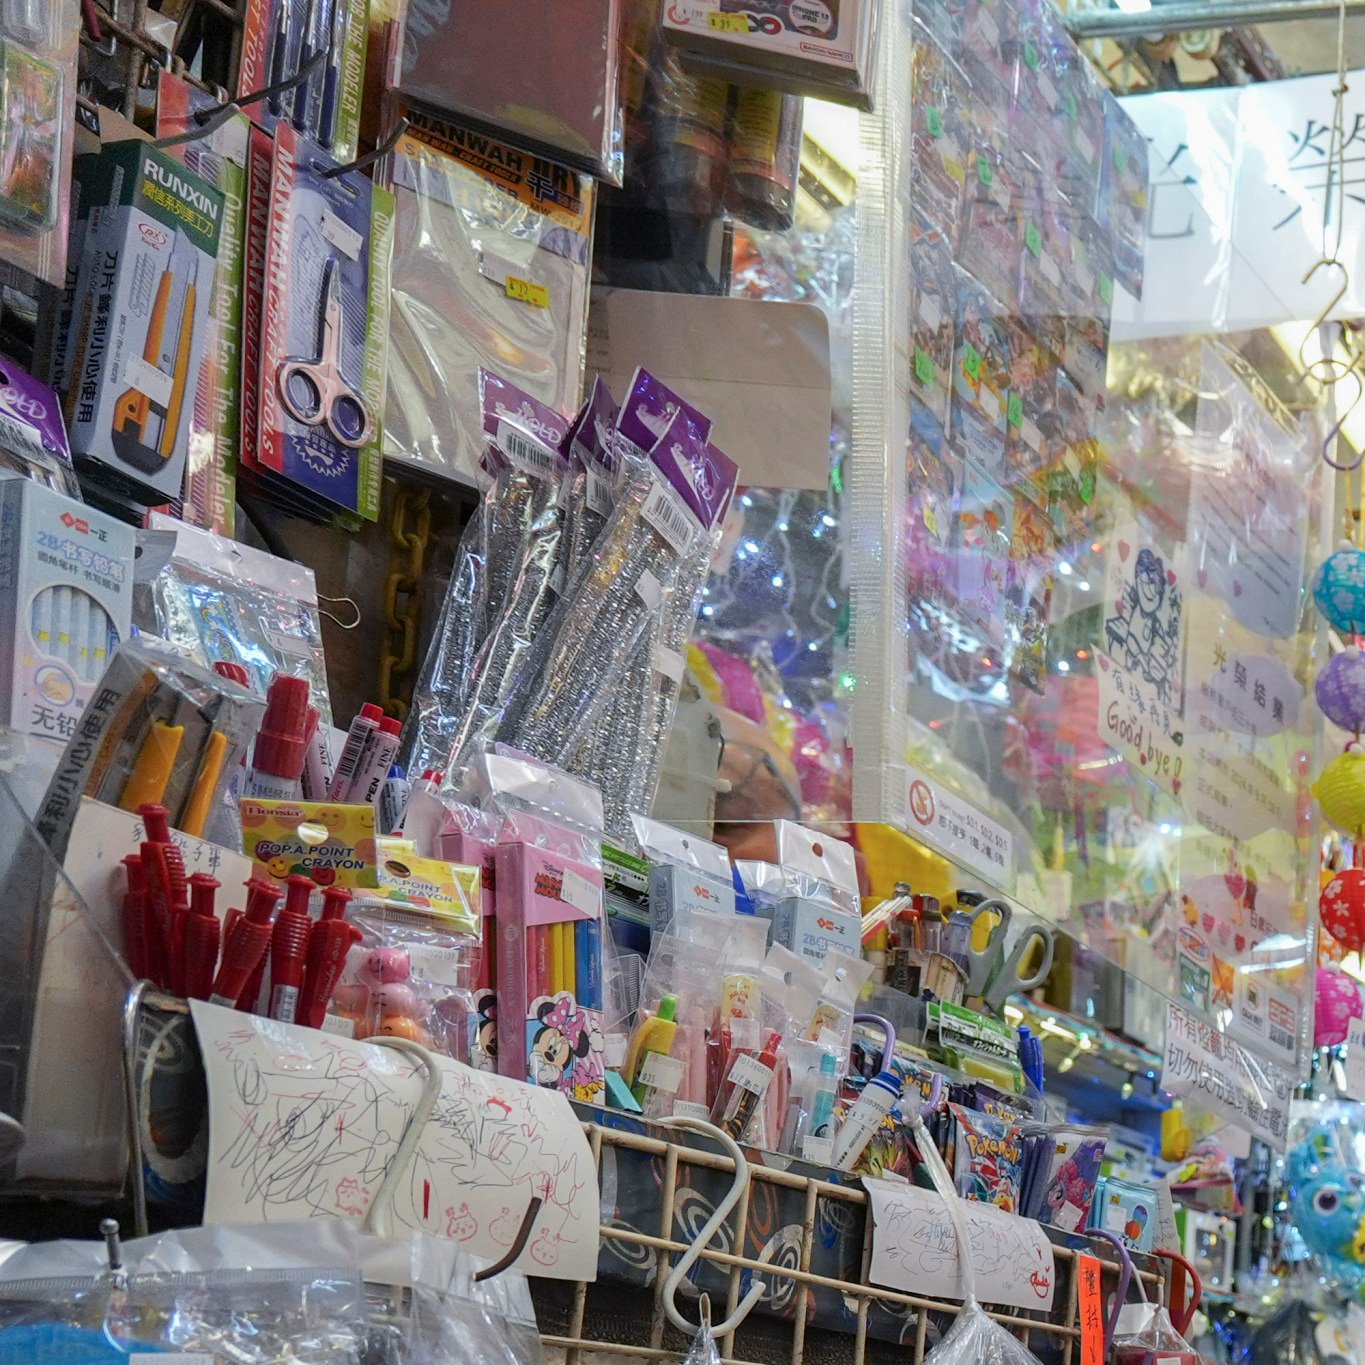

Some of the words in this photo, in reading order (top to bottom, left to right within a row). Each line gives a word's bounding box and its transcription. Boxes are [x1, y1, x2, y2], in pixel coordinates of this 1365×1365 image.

[143, 157, 218, 221] RUNXIN
[267, 144, 297, 287] MANWAH
[1106, 700, 1143, 752] Good
[365, 777, 381, 803] PEN
[259, 843, 355, 858] POP.A.POINT
[302, 857, 365, 870] CRAYON
[398, 886, 453, 903] CRAYON
